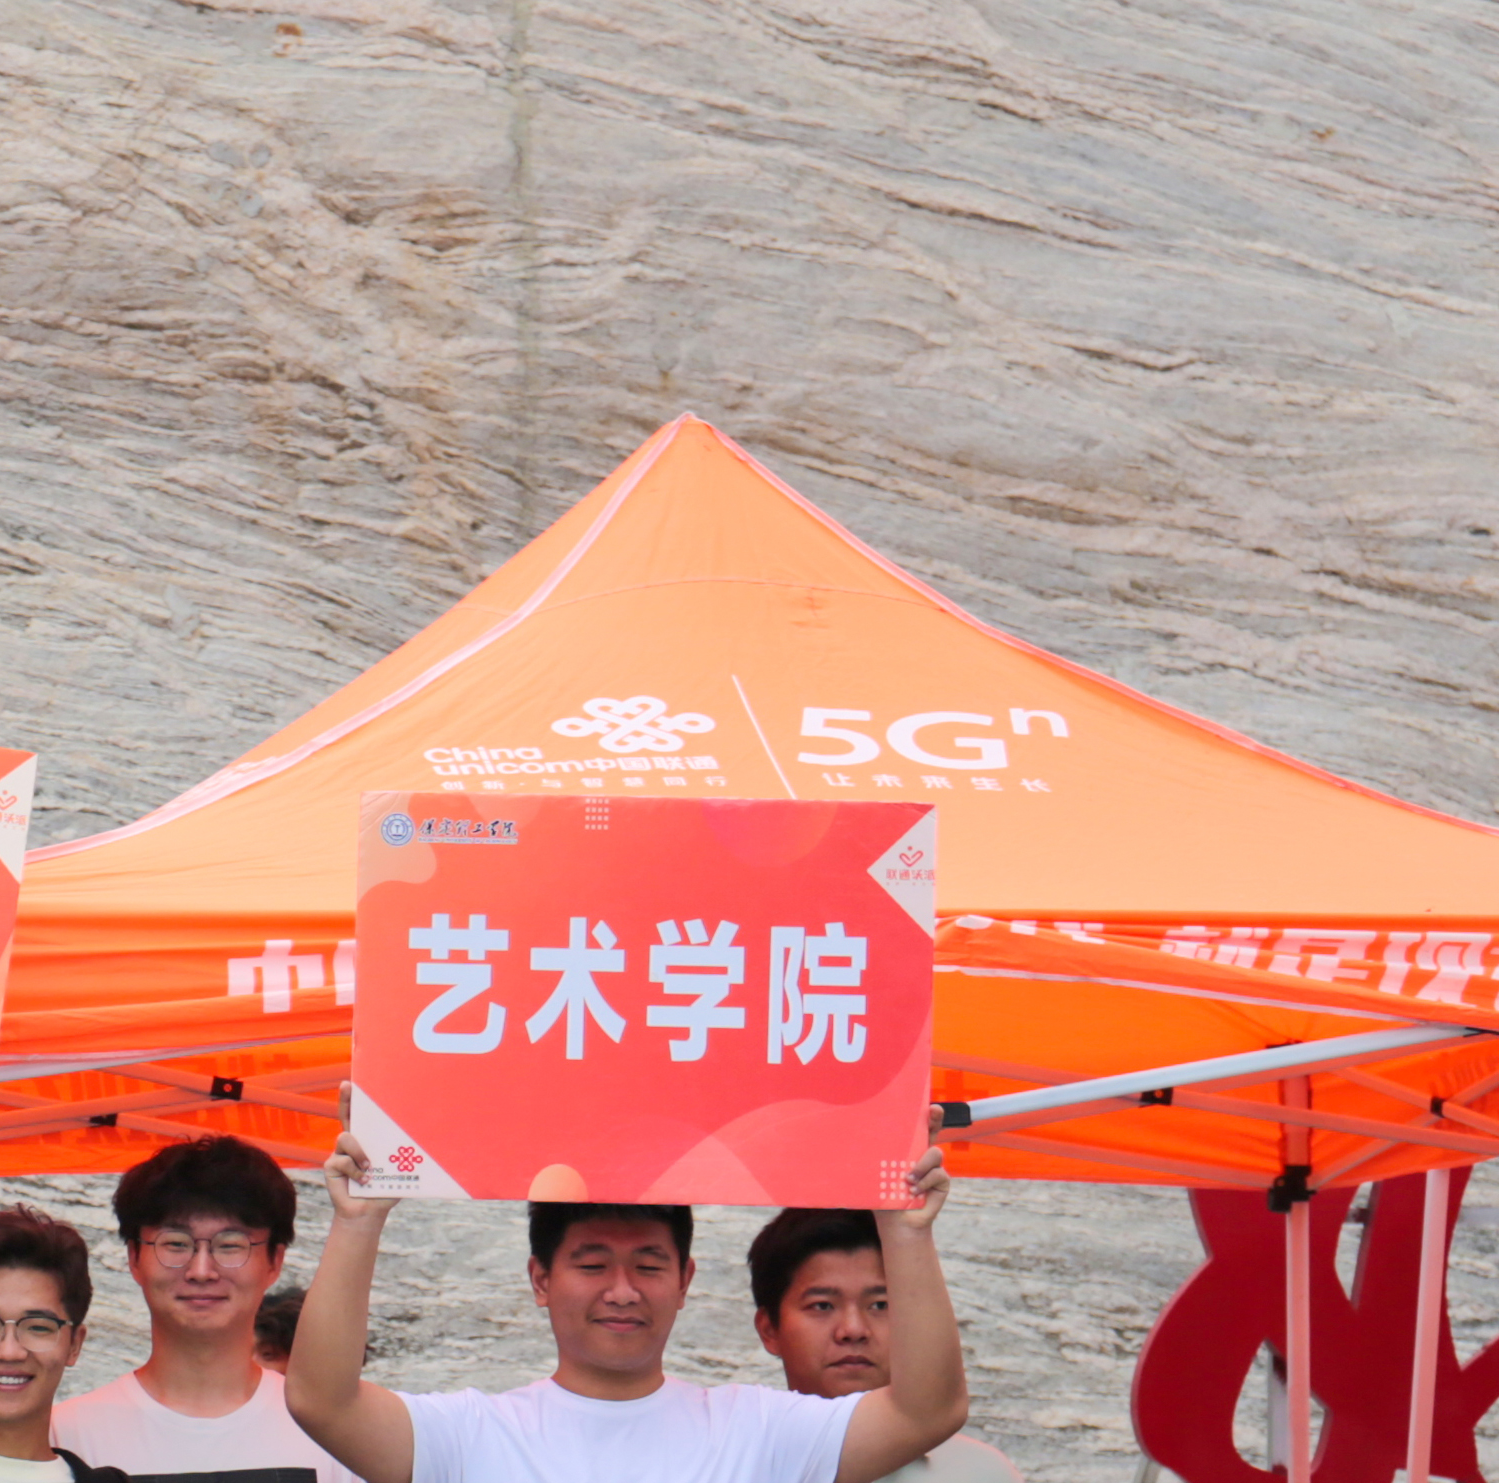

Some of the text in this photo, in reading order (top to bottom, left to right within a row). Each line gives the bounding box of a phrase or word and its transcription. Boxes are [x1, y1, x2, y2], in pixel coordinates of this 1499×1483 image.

[423, 746, 544, 763] China
[821, 772, 1052, 793] 让未来生长
[408, 912, 868, 1066] 艺术学院
